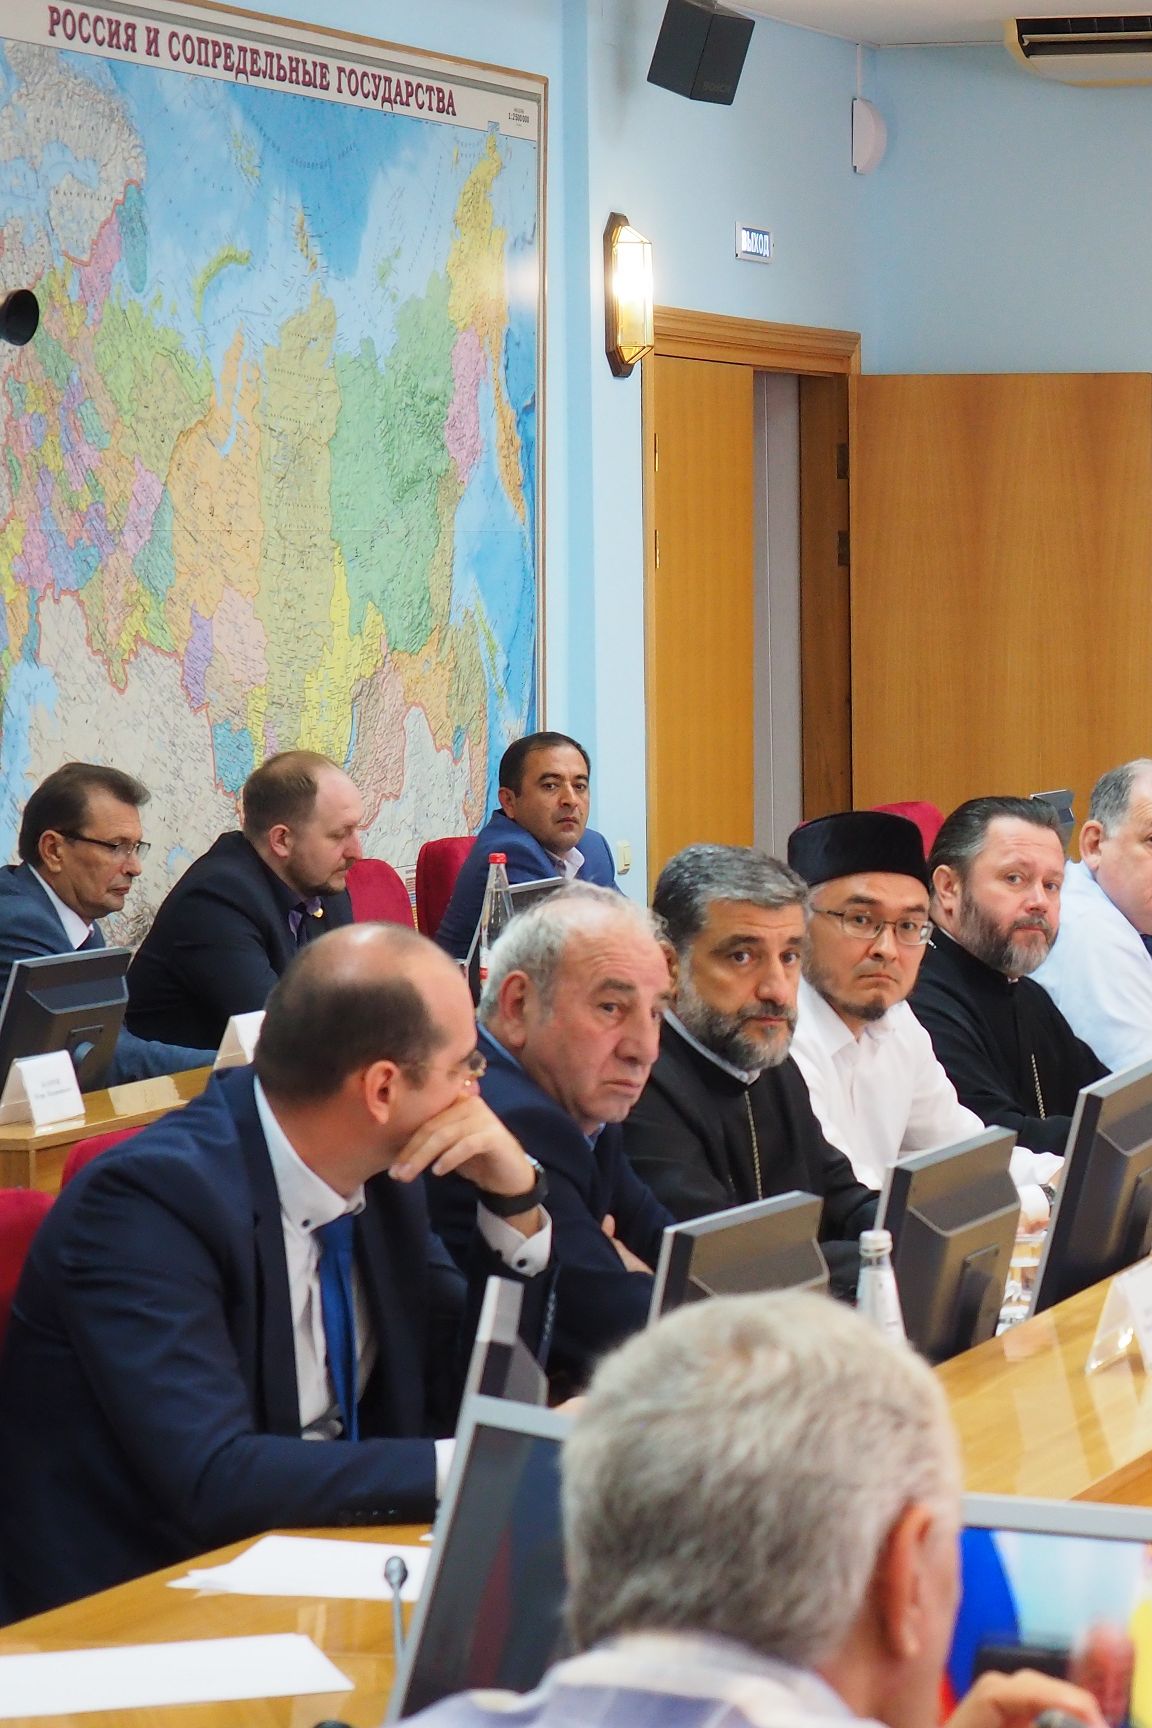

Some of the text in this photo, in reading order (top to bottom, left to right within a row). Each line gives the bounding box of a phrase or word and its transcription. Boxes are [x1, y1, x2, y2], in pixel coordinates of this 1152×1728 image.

[48, 5, 457, 117] РОССИЯ И СОПРЕДЕЛЬНЫЕ ГОСУДАРСТВА
[741, 229, 769, 257] ВЫХОД
